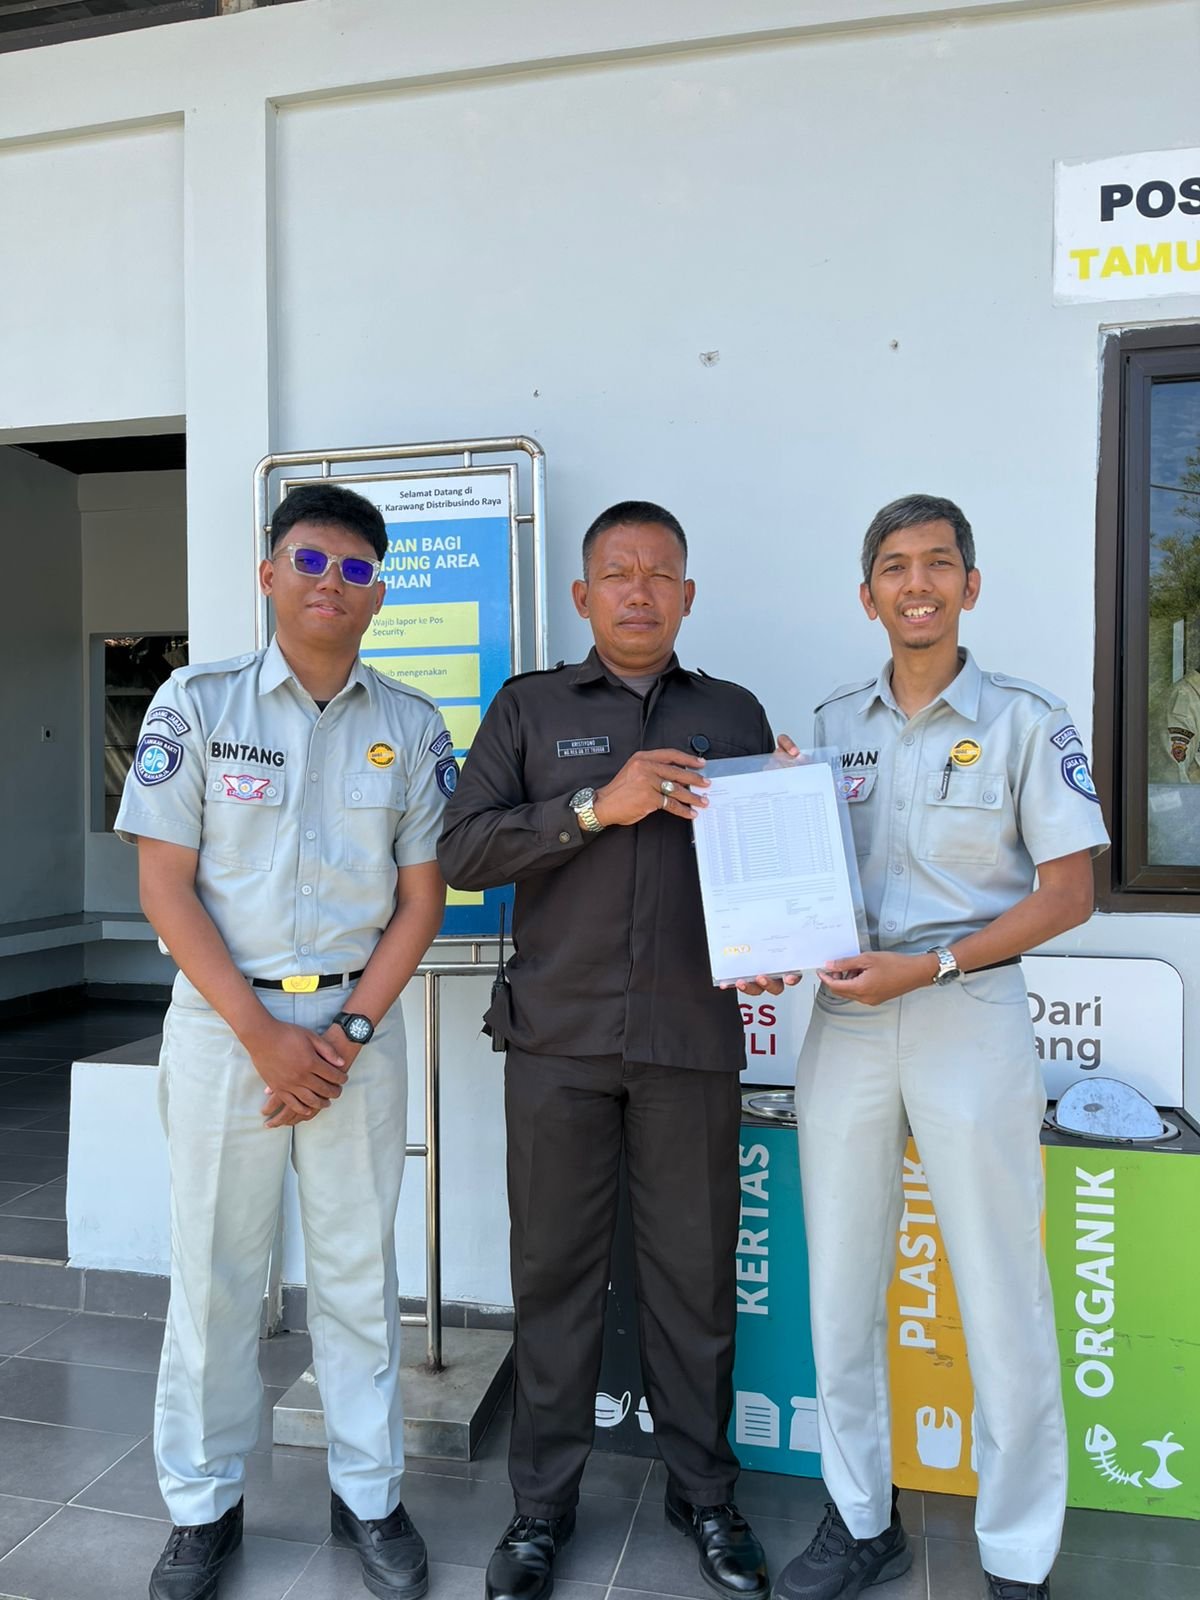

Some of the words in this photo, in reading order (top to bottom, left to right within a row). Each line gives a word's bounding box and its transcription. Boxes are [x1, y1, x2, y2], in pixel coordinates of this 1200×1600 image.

[1100, 177, 1200, 222] POS
[1069, 240, 1200, 280] TAMU
[399, 489, 432, 499] Selamat
[434, 488, 463, 498] Datang
[464, 486, 473, 495] di
[385, 502, 424, 512] Karawang
[426, 498, 480, 509] Distribusindo
[481, 497, 502, 507] Raya
[422, 536, 461, 551] BAGI
[435, 553, 480, 569] AREA
[373, 618, 395, 627] Wajib
[396, 618, 417, 626] lapor
[429, 616, 444, 624] Pos
[396, 668, 447, 678] mengenakan
[211, 742, 284, 767] BINTANG
[1027, 992, 1101, 1026] Dari
[751, 1033, 776, 1055] LI
[736, 1143, 769, 1315] KERTAS
[899, 1156, 937, 1349] PLASTIK
[1075, 1166, 1115, 1398] ORGANIK
